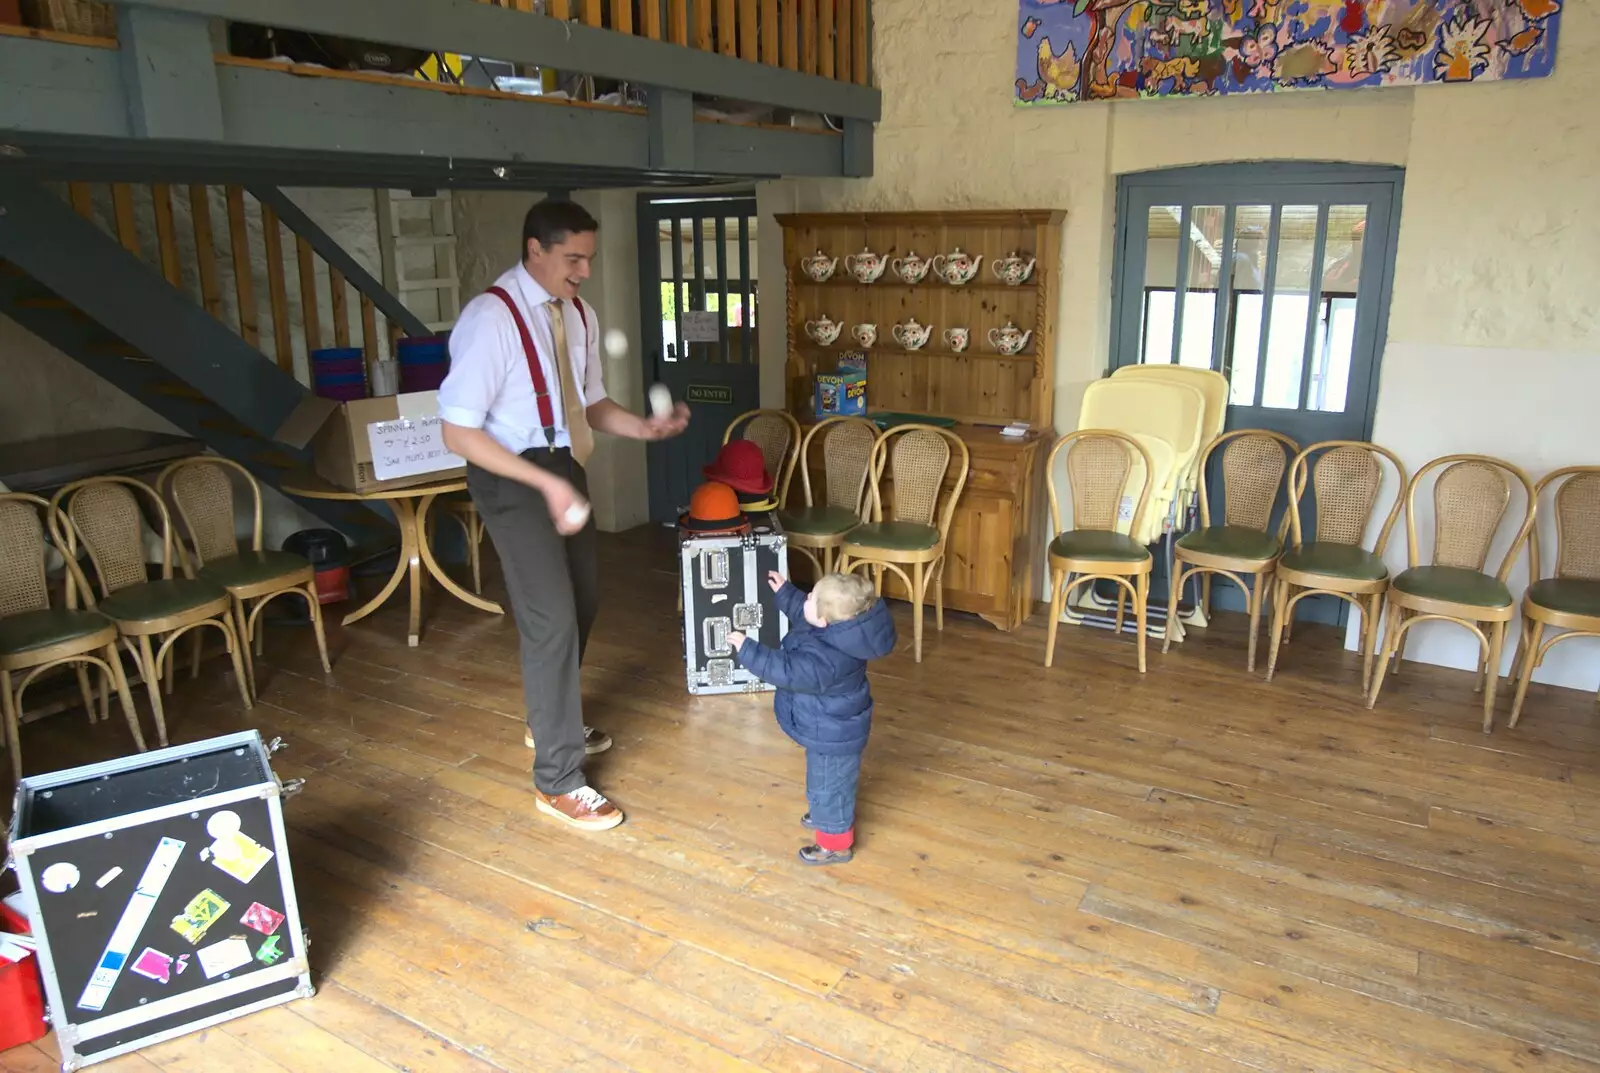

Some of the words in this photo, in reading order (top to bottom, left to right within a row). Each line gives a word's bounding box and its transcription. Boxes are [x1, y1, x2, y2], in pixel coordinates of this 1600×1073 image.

[839, 351, 864, 360] DEVON
[817, 376, 844, 384] DEVON
[691, 389, 702, 397] NO
[702, 389, 728, 399] ENTRY
[847, 387, 865, 398] DEVON
[376, 421, 416, 435] SPINNING
